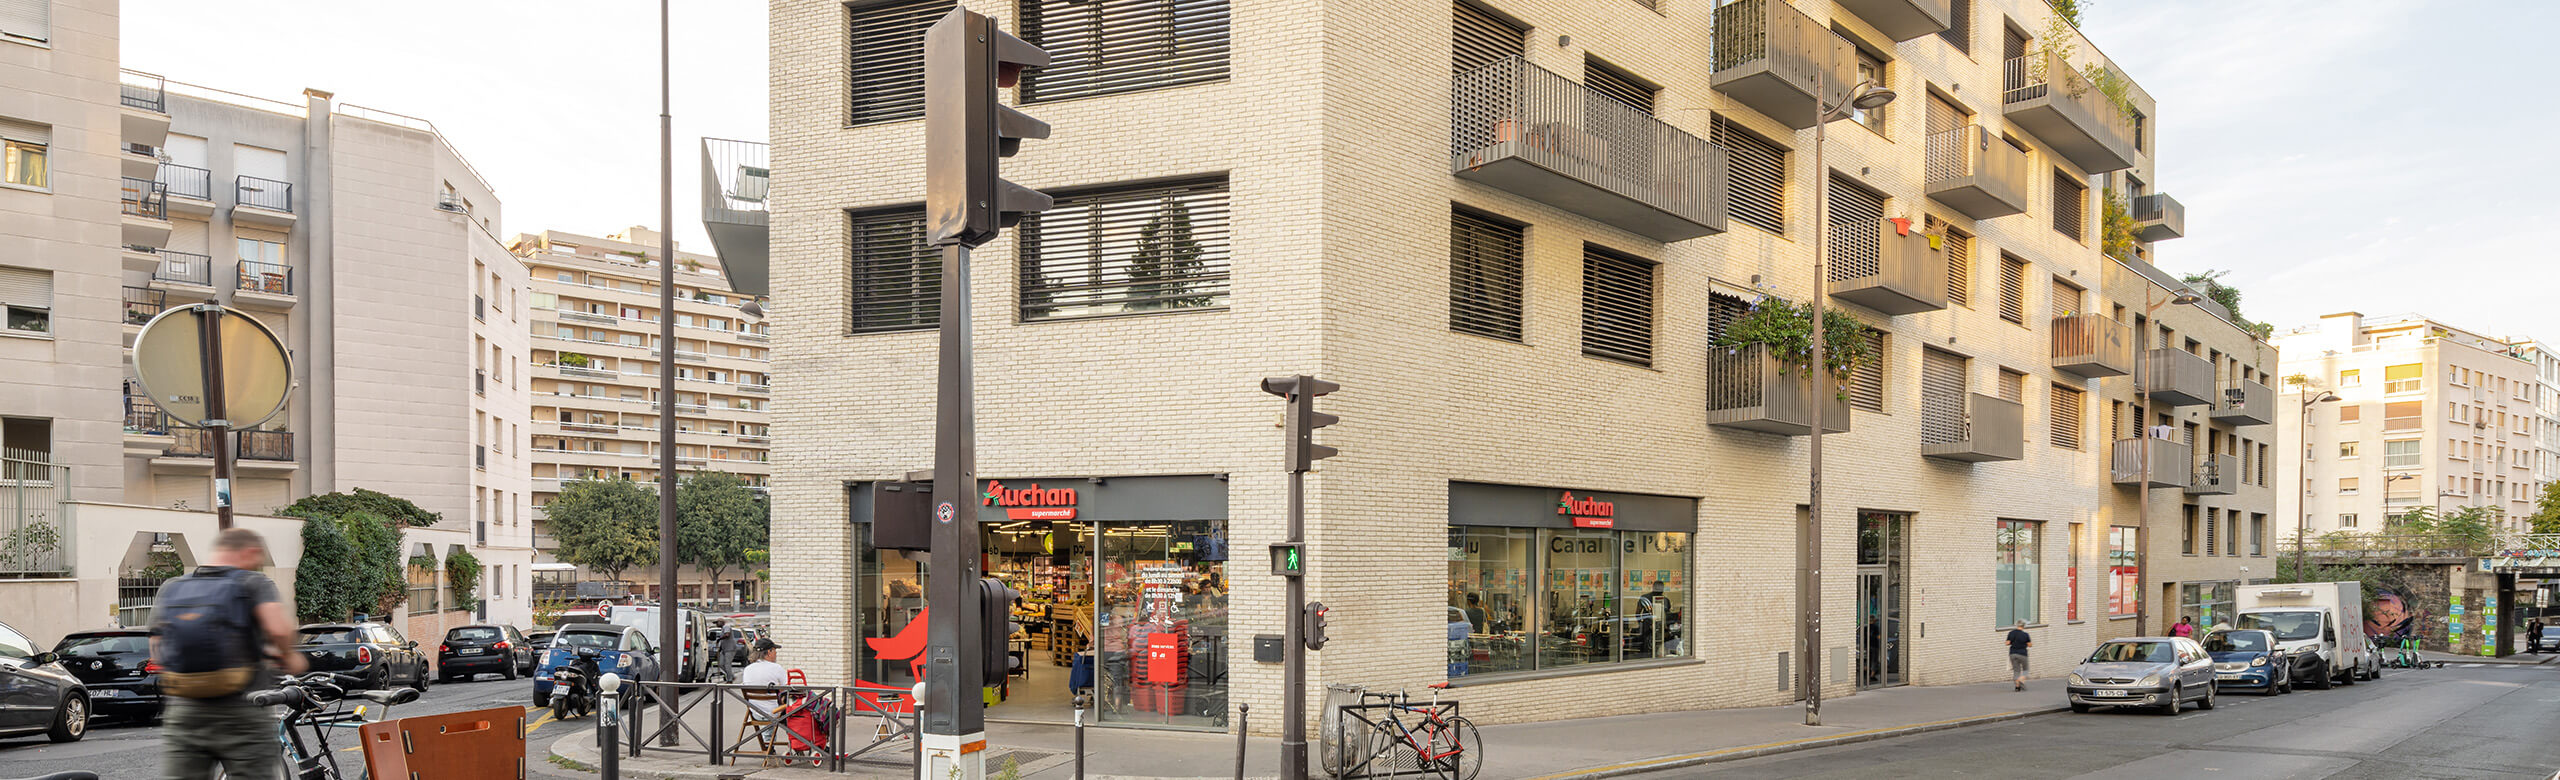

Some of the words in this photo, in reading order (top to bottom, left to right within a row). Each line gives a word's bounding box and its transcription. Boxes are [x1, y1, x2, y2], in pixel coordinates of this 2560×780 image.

[982, 480, 1077, 507] Auchan
[1557, 491, 1614, 517] Auchan
[1031, 509, 1071, 518] supermarché
[1551, 535, 1603, 553] Canal
[1624, 539, 1635, 553] e
